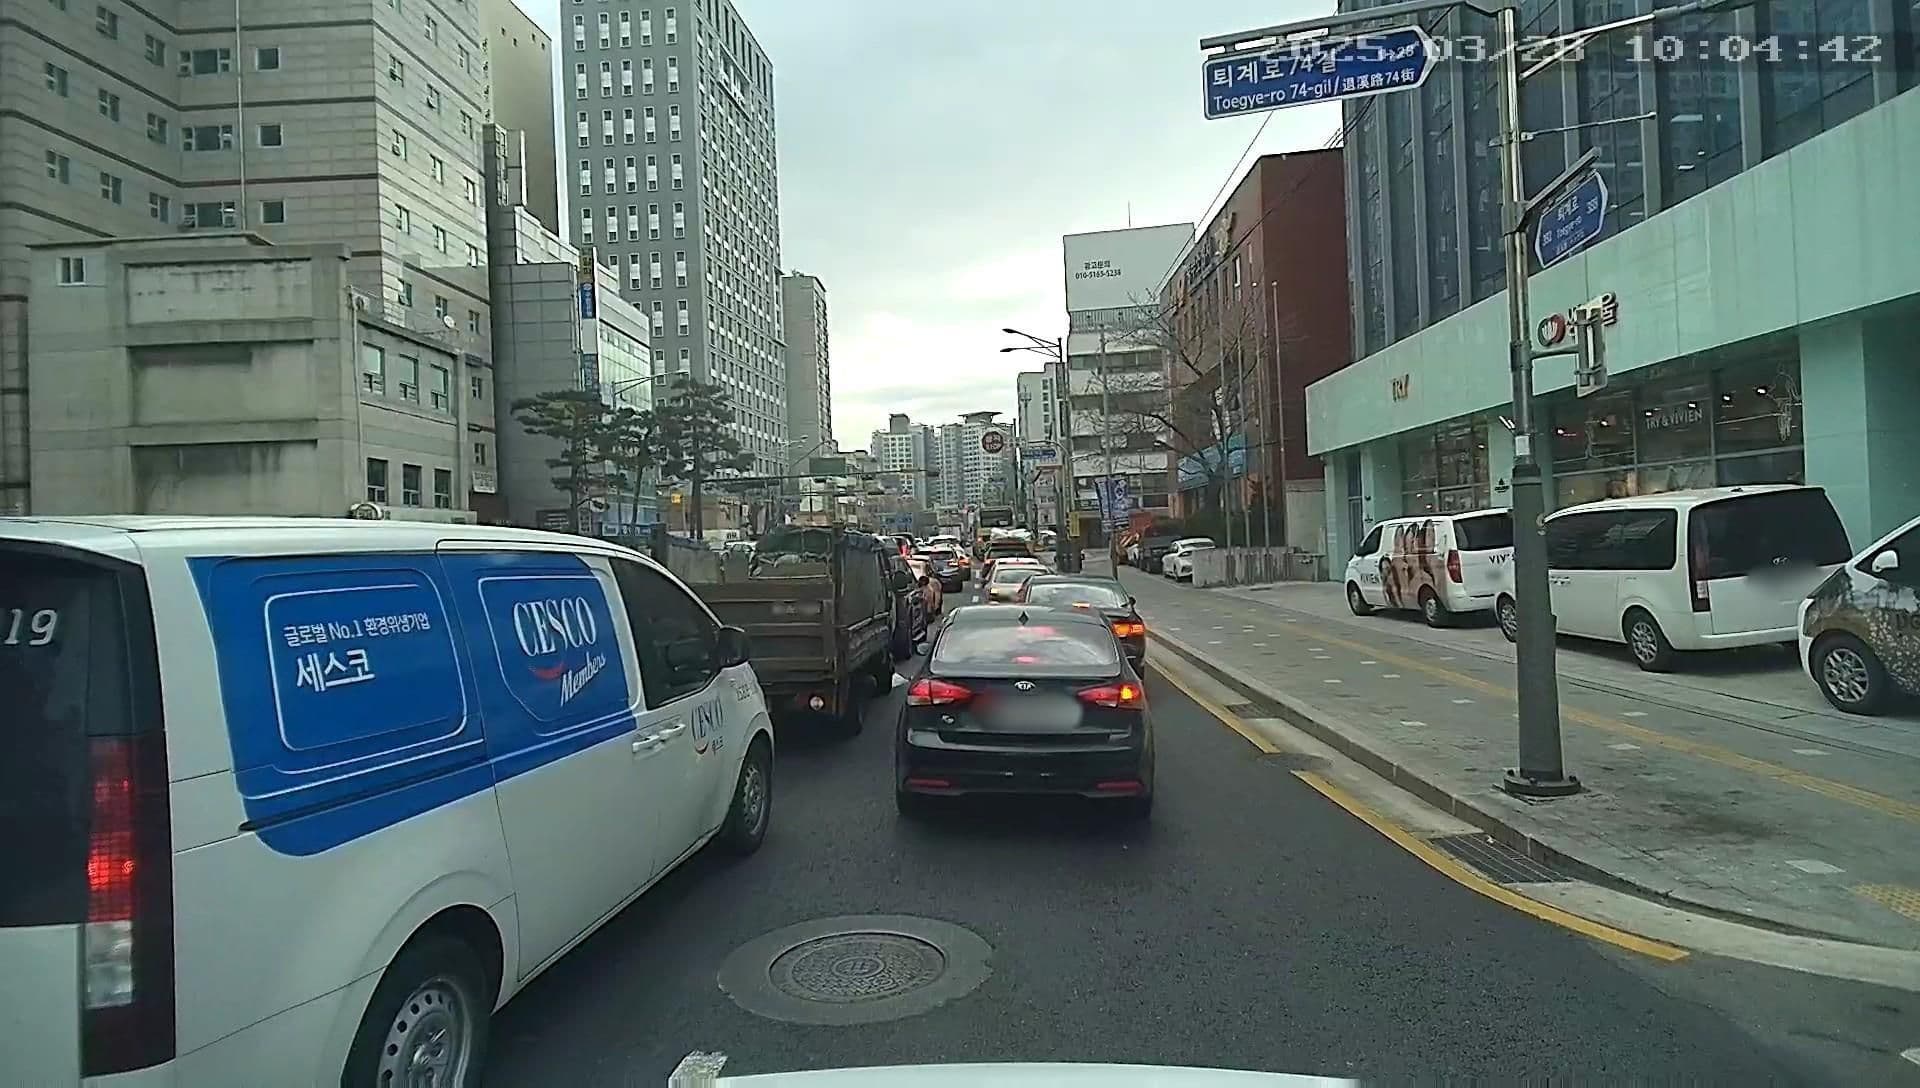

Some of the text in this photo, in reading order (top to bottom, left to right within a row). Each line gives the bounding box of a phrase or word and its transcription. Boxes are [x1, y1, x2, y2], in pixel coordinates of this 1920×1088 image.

[1212, 58, 1284, 88] 퇴계로
[1213, 91, 1287, 111] Toegye-ro
[1557, 195, 1579, 221] 퇴계로
[283, 611, 431, 647] 글로벌 No.1 환경위생기업
[513, 596, 597, 656] CESCO
[296, 648, 376, 692] 세스코
[560, 651, 606, 707] Members
[691, 696, 724, 742] CESCO
